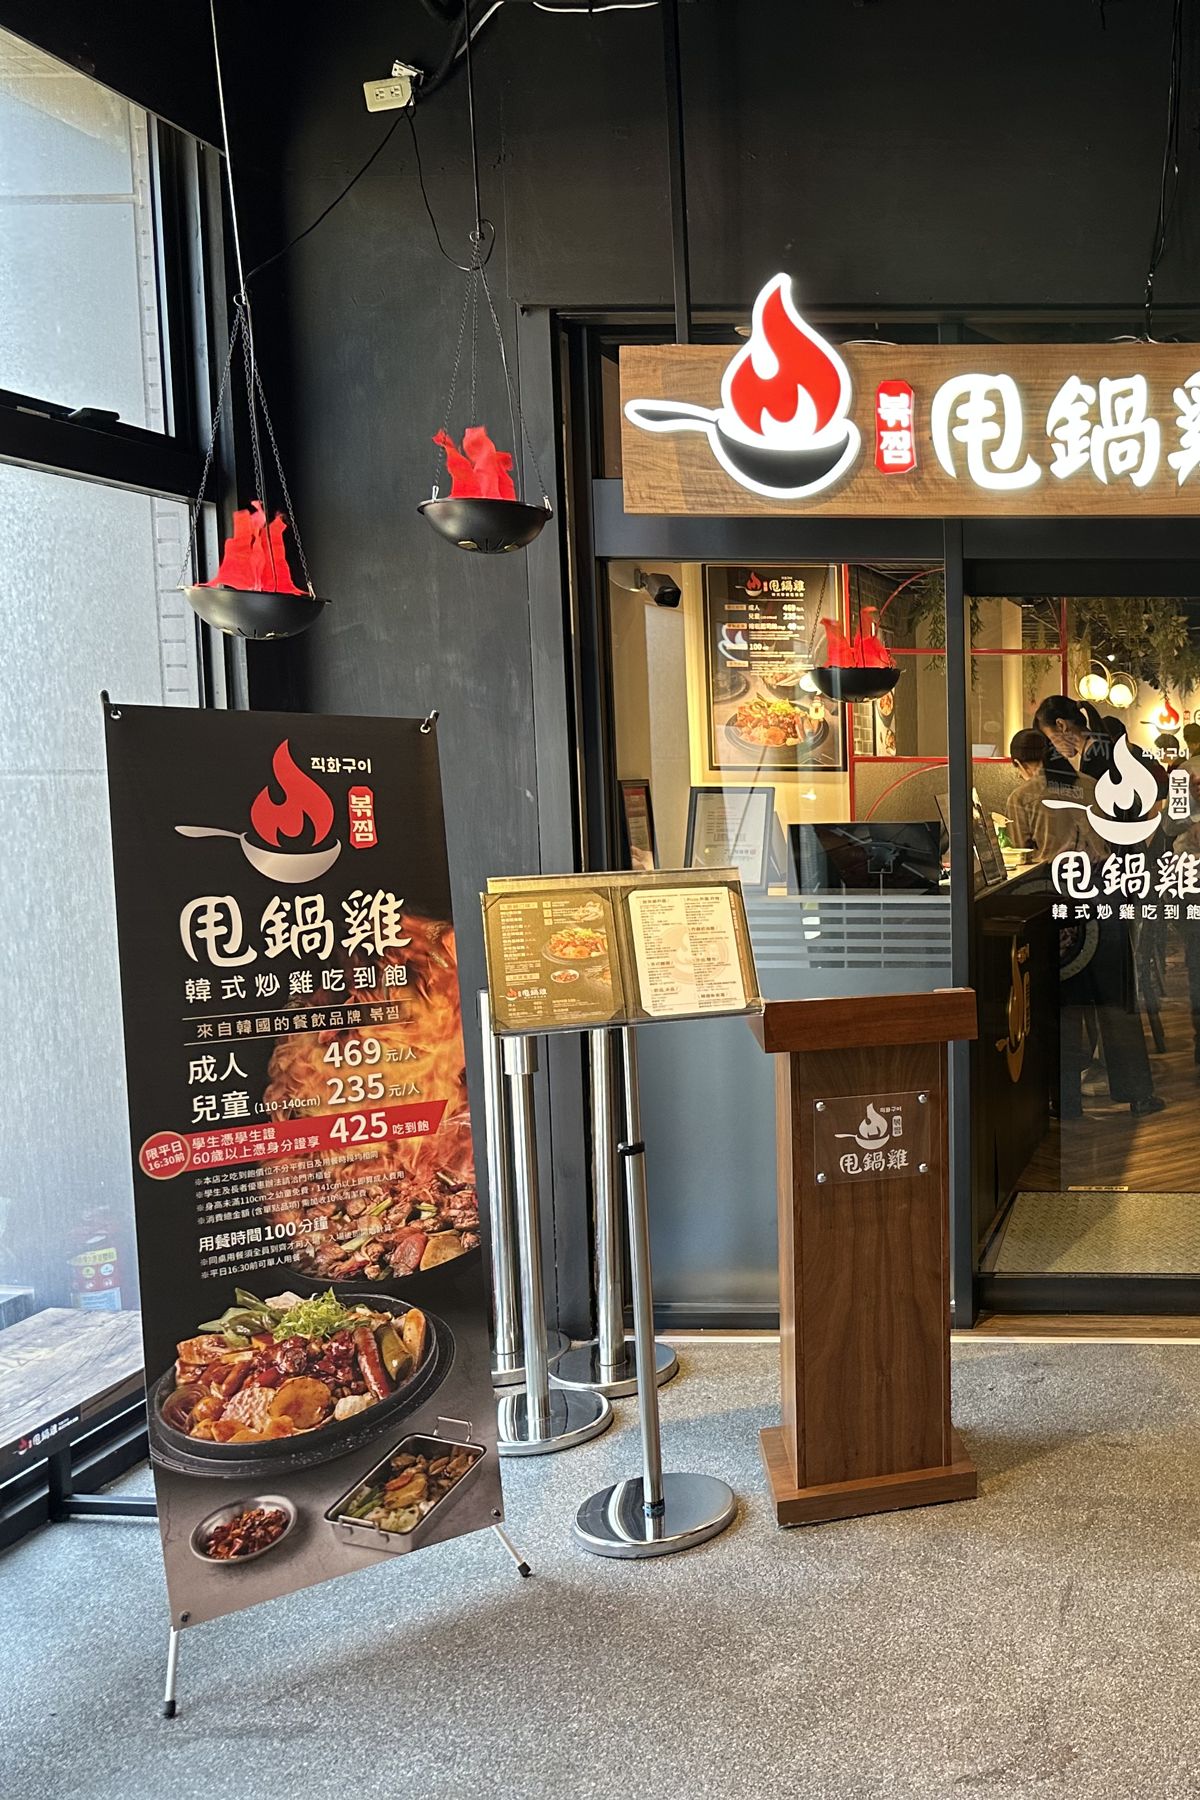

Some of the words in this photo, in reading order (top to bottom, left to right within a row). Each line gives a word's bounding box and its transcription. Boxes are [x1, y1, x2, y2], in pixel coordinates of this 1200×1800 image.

[310, 757, 372, 775] 직화구이
[1171, 777, 1188, 813] 볶찜
[350, 794, 375, 843] 볶찜
[180, 889, 412, 967] 甩鍋雞
[185, 963, 408, 1003] 韓式炒雞吃到飽
[197, 1009, 362, 1039] 來自韓國的餐飲品牌
[188, 1052, 248, 1085] 成人
[323, 1038, 382, 1068] 469
[191, 1091, 251, 1124] 兒童
[254, 1095, 321, 1115] (110-140cm)
[327, 1073, 385, 1105] 235
[192, 1127, 276, 1151] 學生憑學生證
[330, 1111, 388, 1144] 425
[392, 1120, 430, 1135] 吃到飽
[145, 1141, 183, 1159] 限平日
[148, 1152, 186, 1171] 16:30前
[192, 1136, 321, 1166] 60歲以上憑身分證享
[840, 1149, 910, 1175] 甩鍋雞
